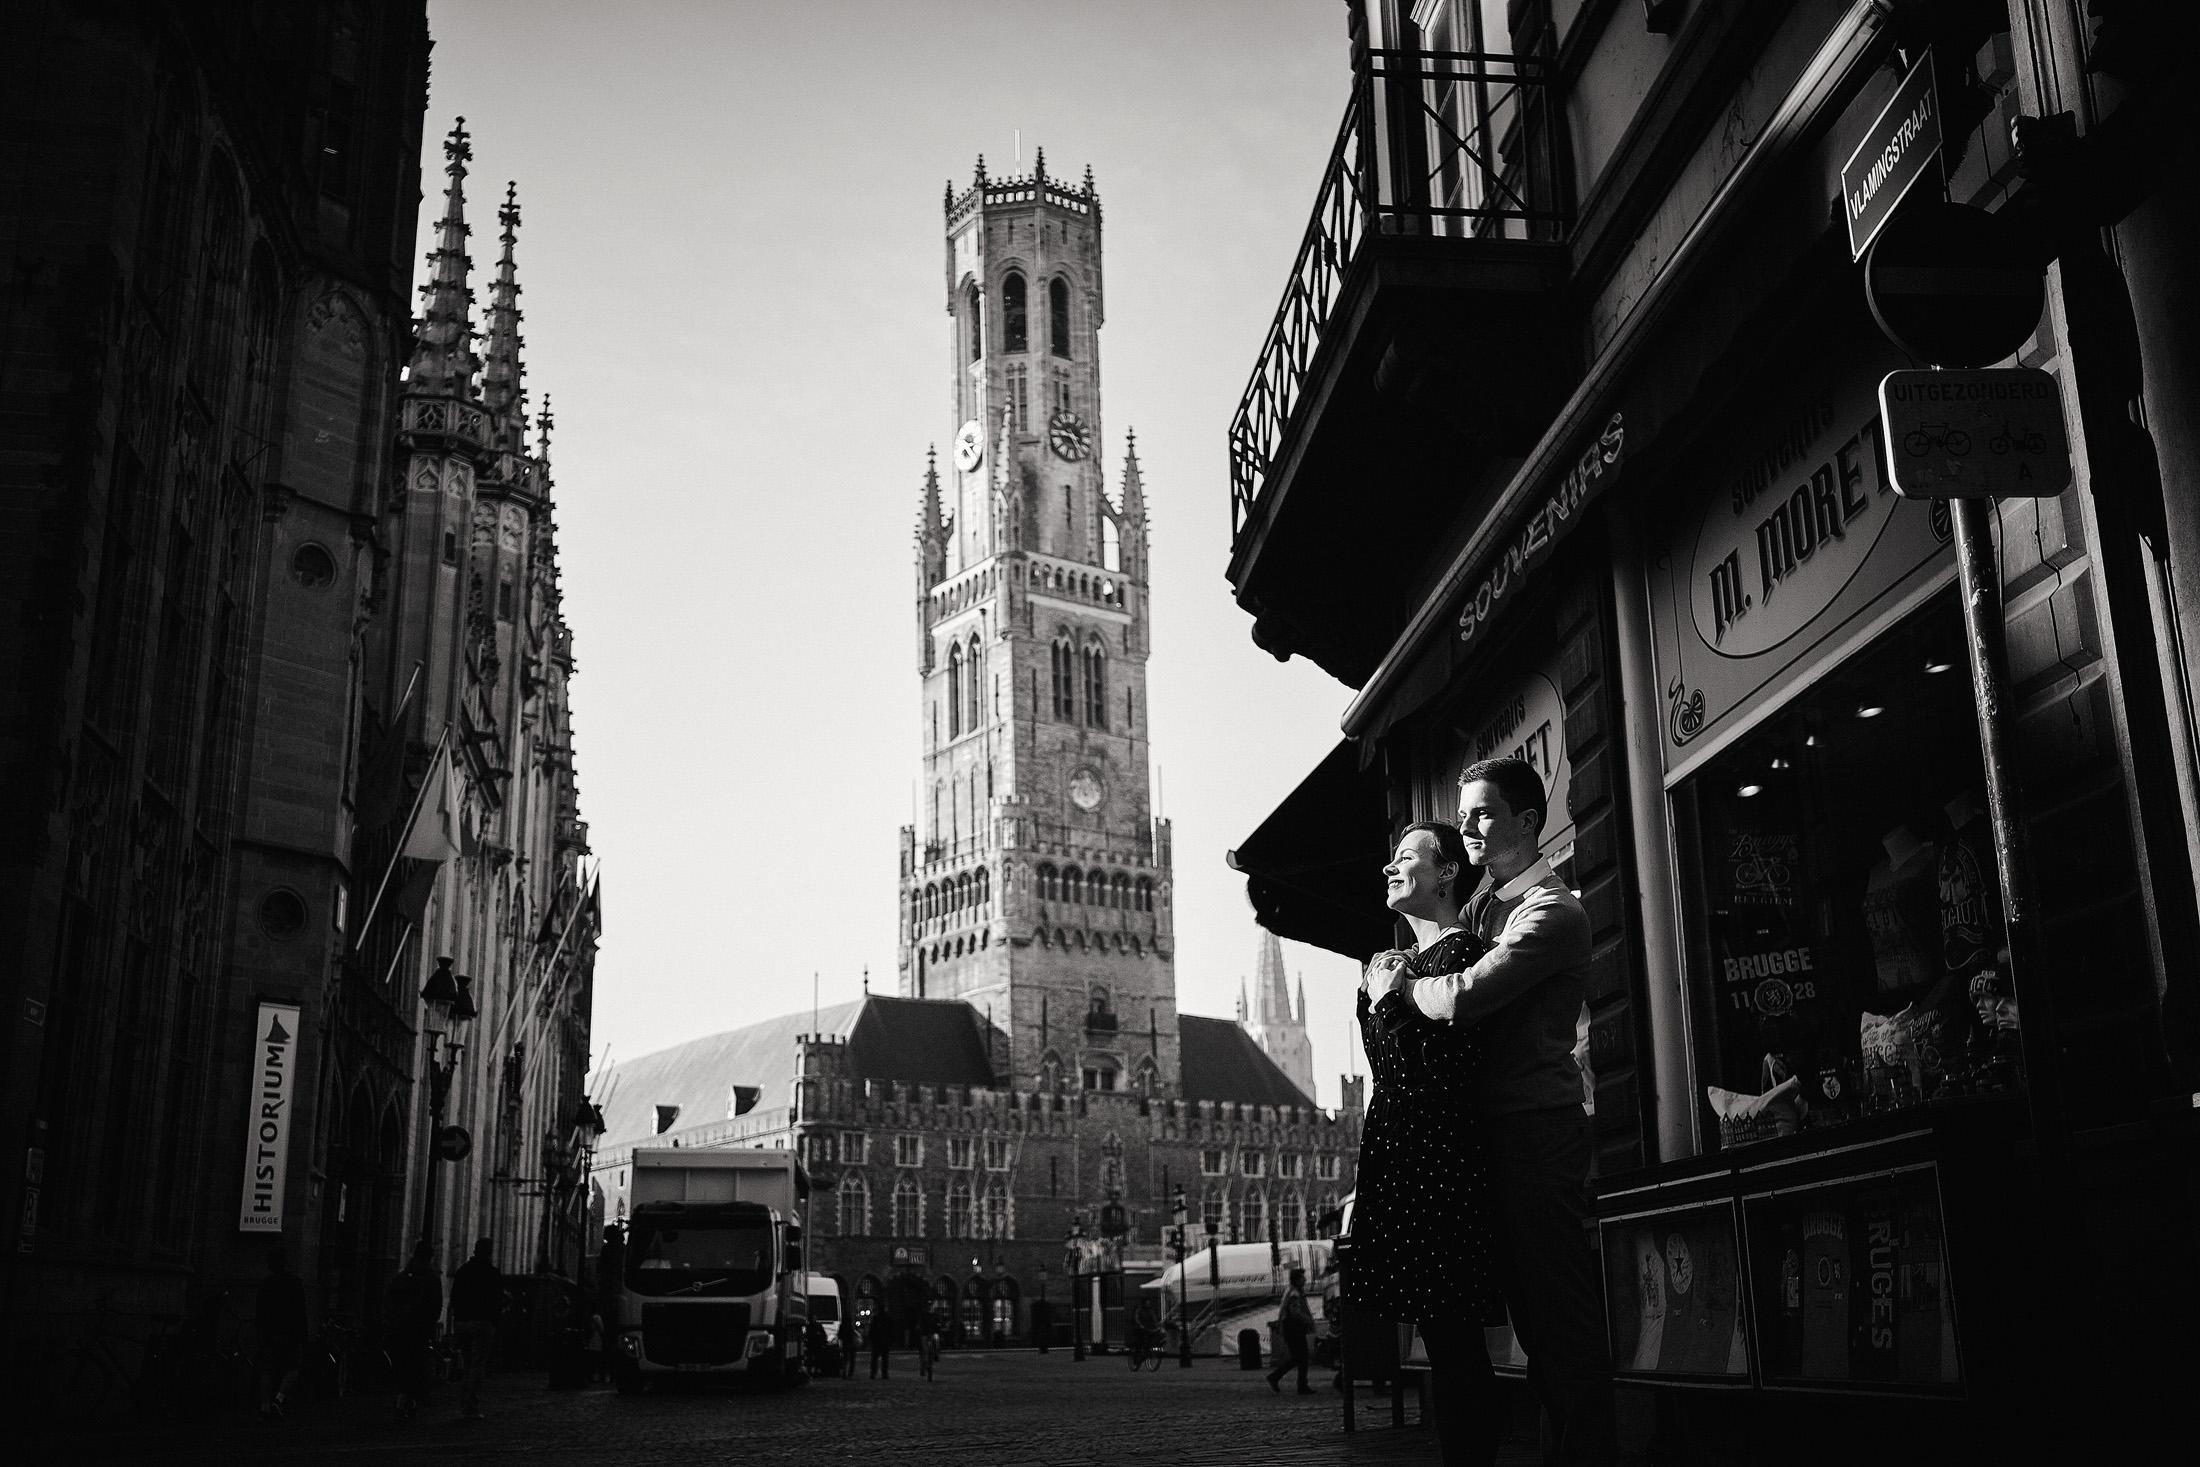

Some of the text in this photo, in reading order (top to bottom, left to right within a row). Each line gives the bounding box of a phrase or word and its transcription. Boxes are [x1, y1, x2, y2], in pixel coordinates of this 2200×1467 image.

[1849, 87, 1933, 221] VLAMINGSTRAAT
[1893, 382, 2049, 402] UITGEZONDERD
[2018, 461, 2033, 480] A
[1458, 411, 1625, 642] SOUVENIRS
[1755, 413, 1890, 607] MORET
[1723, 945, 1815, 984] BRUGGE
[1730, 980, 1817, 1010] 11 28
[253, 1044, 286, 1213] HISTORIUM
[243, 1215, 279, 1225] BRUGGE
